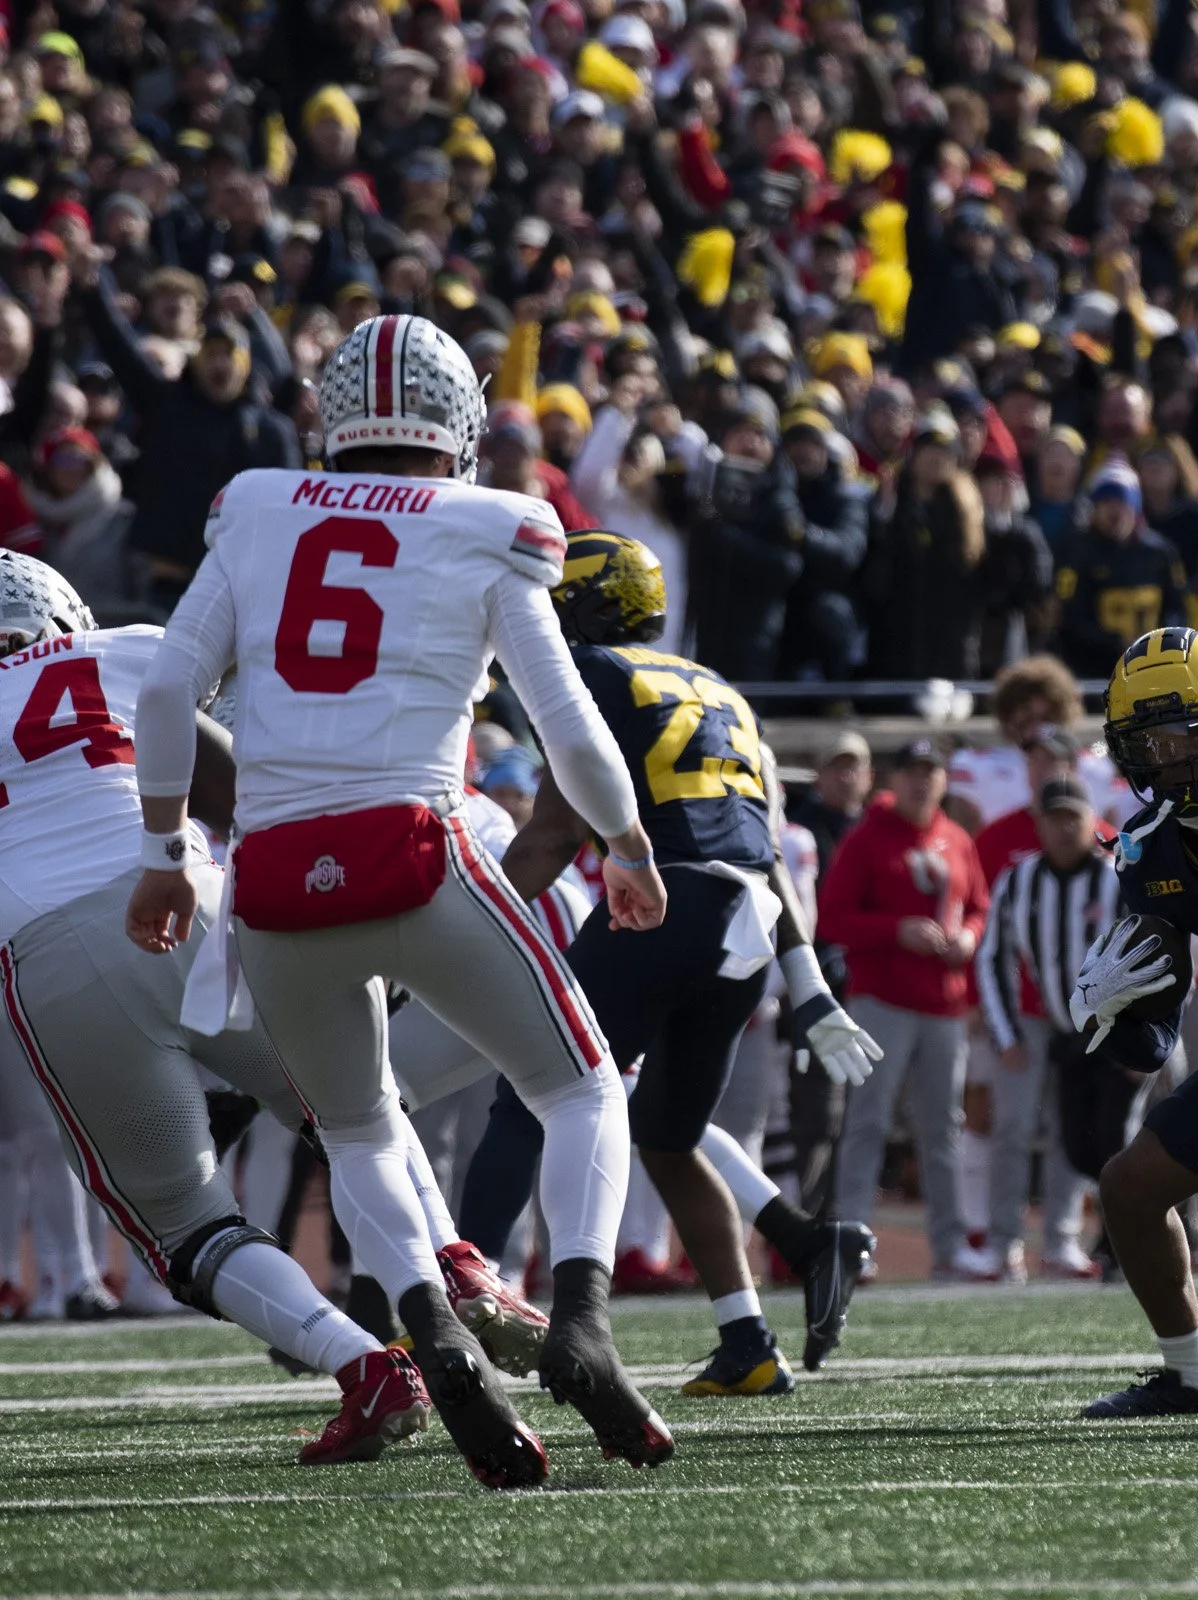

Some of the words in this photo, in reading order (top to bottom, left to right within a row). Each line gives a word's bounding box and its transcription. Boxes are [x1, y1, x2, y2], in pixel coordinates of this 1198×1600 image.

[292, 478, 437, 514] McCORD
[337, 427, 437, 443] BUCKEYES
[274, 516, 400, 694] 6
[0, 657, 136, 809] 4
[630, 669, 767, 806] 23
